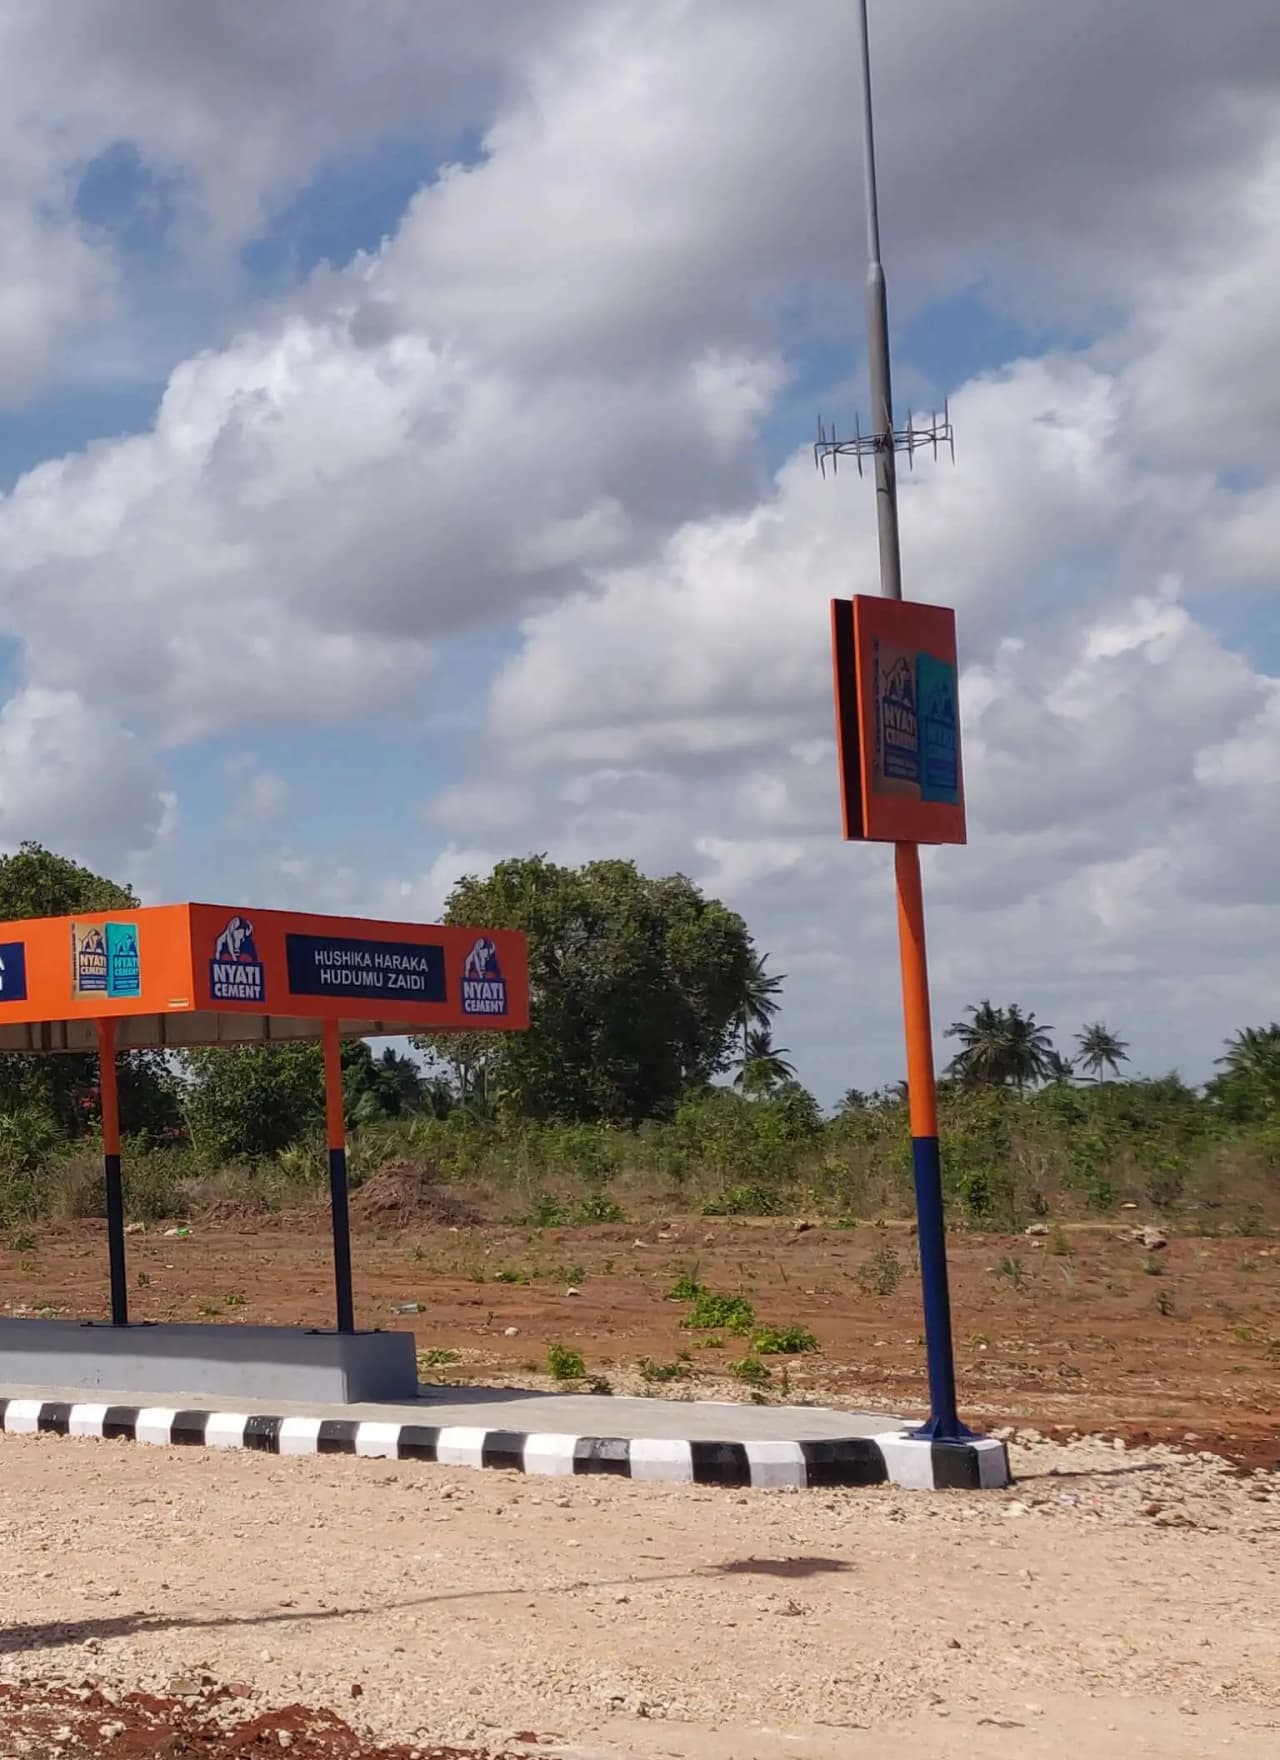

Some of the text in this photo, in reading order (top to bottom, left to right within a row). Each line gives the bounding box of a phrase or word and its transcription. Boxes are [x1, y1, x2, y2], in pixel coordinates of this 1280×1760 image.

[314, 950, 428, 972] HUSHIKA HARAKA
[214, 964, 261, 985] NYATI
[320, 969, 425, 990] HUDUMU ZAIDI
[214, 984, 262, 999] CEMENT
[463, 981, 504, 1000] NYATI
[464, 999, 504, 1013] CEMENT
